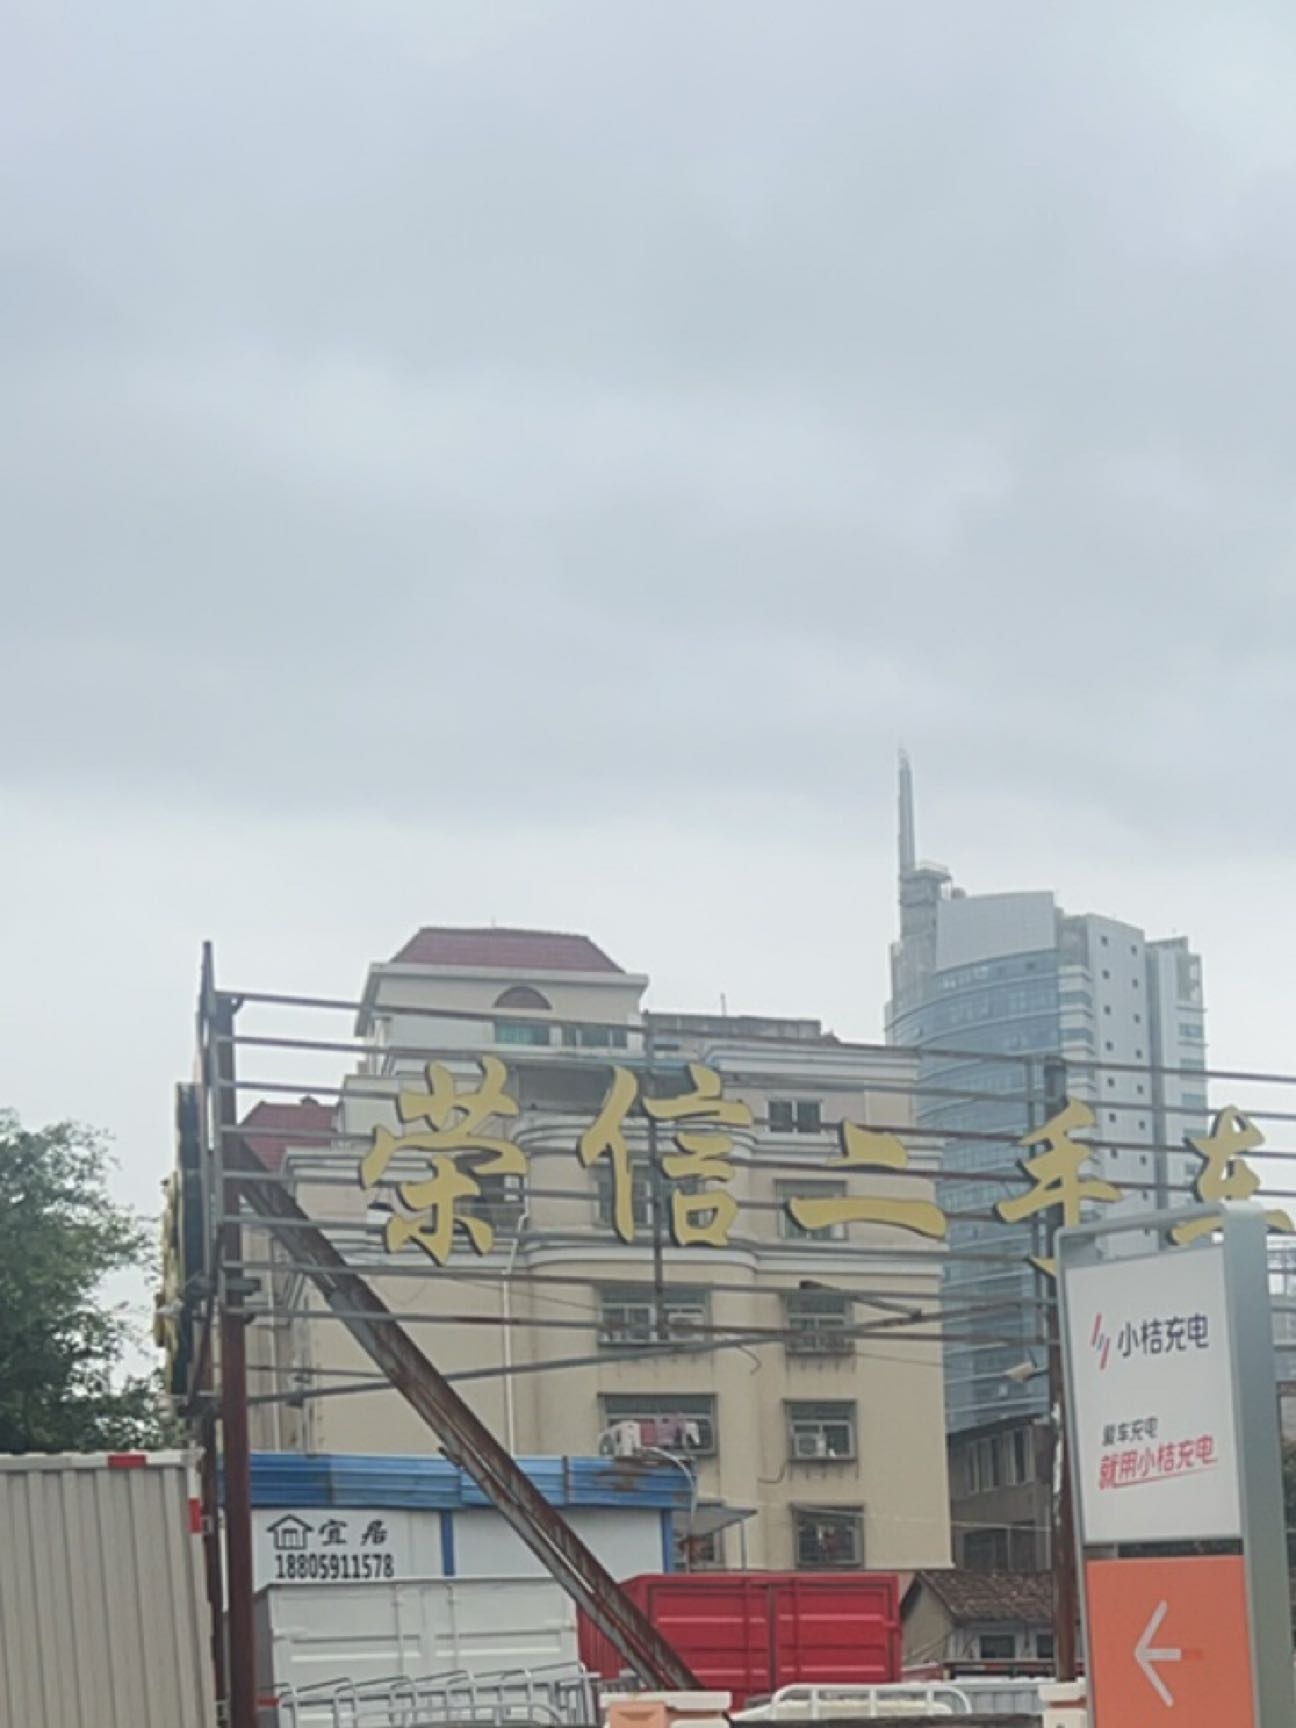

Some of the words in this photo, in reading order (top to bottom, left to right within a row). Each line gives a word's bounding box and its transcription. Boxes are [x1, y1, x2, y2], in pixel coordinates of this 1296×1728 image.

[1117, 1312, 1209, 1358] 小桔充电
[1100, 1434, 1217, 1491] 就用小桔充电
[318, 1518, 388, 1547] 宜居
[275, 1553, 395, 1580] 18805911578
